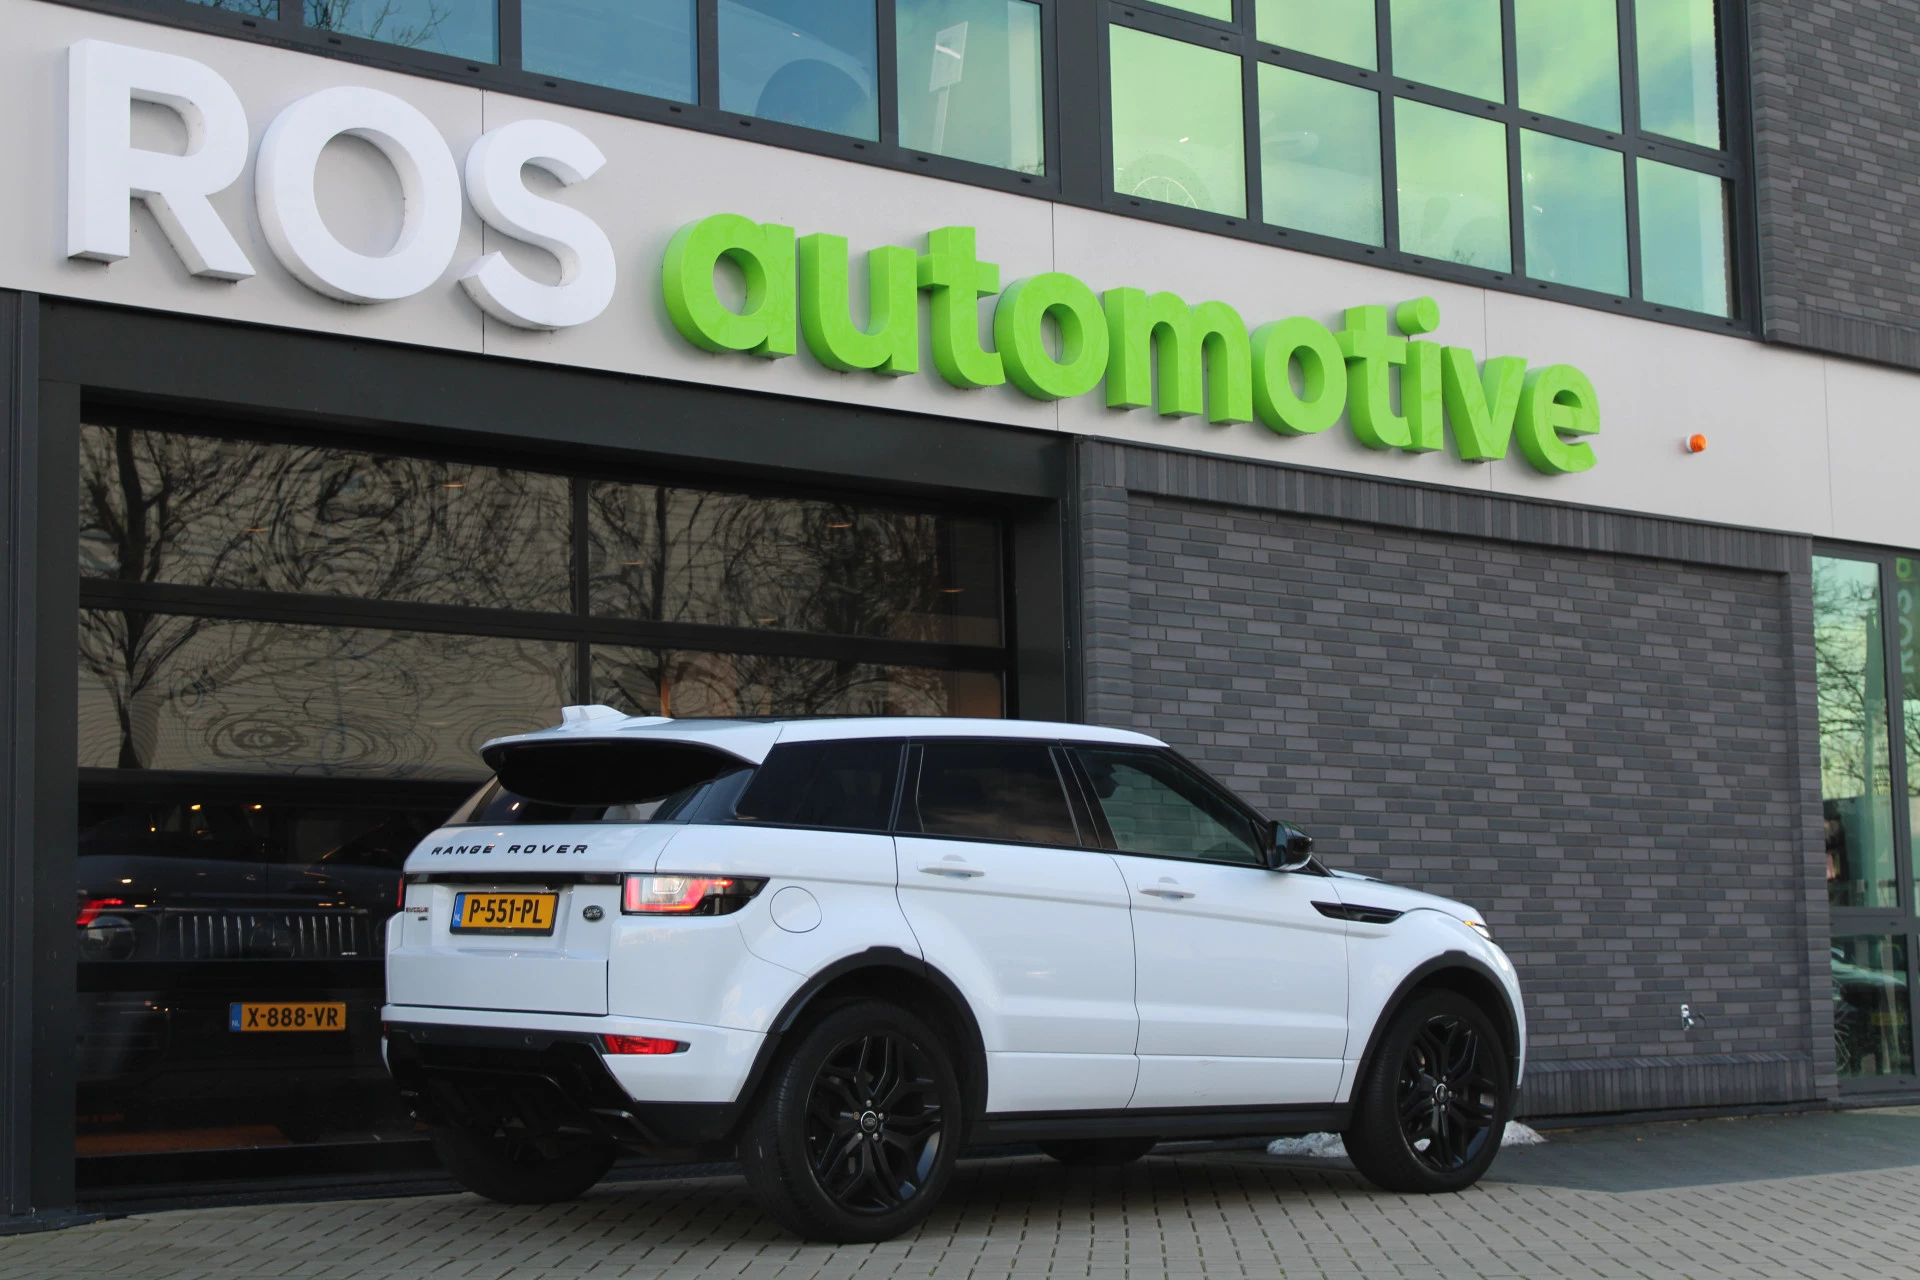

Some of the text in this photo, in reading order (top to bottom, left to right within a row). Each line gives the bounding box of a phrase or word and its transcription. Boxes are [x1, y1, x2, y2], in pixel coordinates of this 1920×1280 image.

[67, 38, 1600, 475] ROS automotive
[431, 844, 588, 856] RANGE ROVER
[468, 898, 543, 924] P-551-PL
[247, 1007, 338, 1028] X-888-VR
